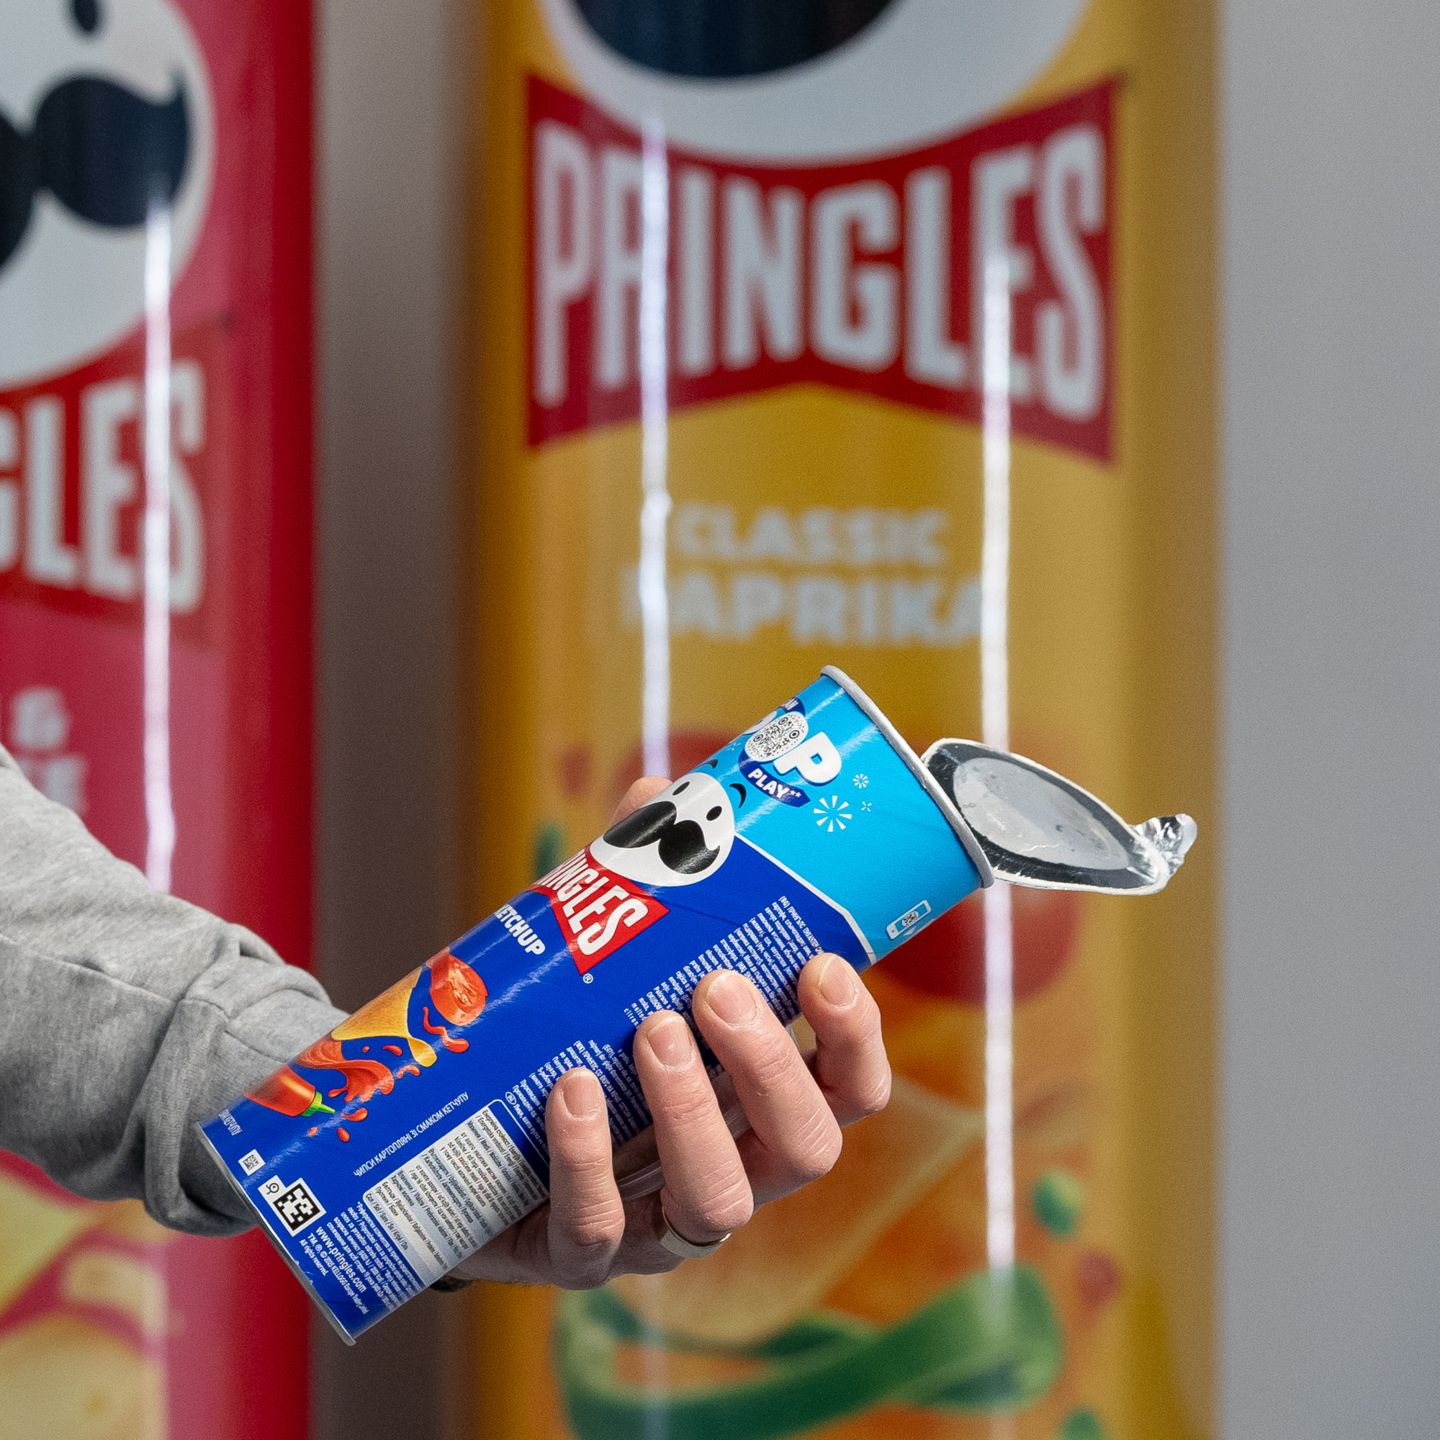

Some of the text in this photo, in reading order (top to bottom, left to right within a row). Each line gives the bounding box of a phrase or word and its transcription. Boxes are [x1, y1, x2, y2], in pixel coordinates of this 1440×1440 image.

[533, 125, 1107, 422] PRINGLES
[675, 503, 948, 566] CLASSIC
[536, 848, 649, 956] RINGLES
[353, 1158, 377, 1177] ЧИПСИ
[416, 1110, 444, 1133] СМАКОМ
[441, 1092, 469, 1115] КЕТЧУПУ
[316, 1226, 366, 1292] www.pringles.com
